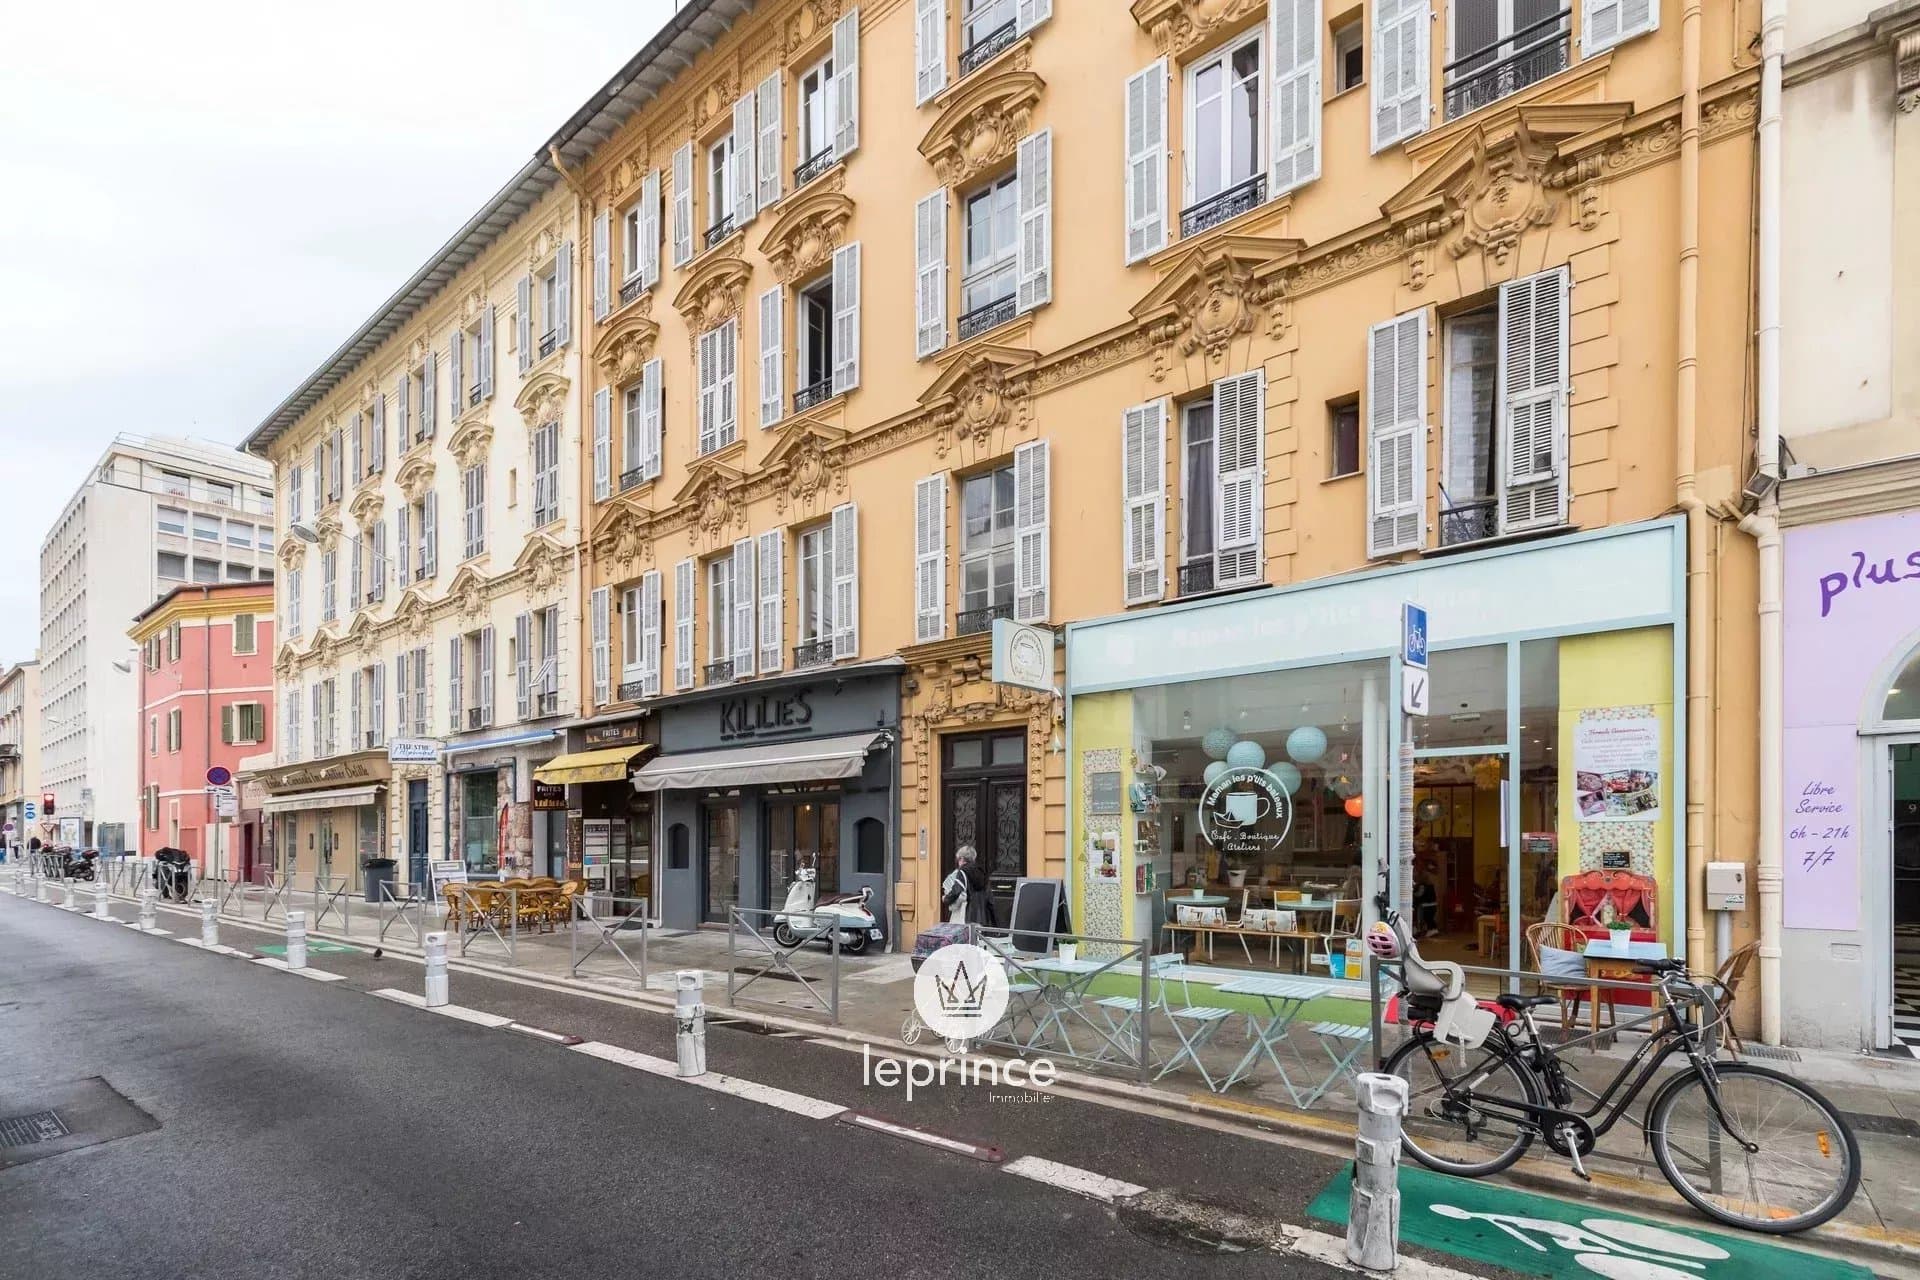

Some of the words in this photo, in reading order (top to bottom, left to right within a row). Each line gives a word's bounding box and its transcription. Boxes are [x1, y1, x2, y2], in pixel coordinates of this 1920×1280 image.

[602, 728, 620, 737] FRITES
[1802, 781, 1835, 796] Libre
[1206, 779, 1232, 806] Maman
[1232, 774, 1246, 784] les
[1265, 783, 1283, 819] bateaux
[1795, 798, 1843, 814] Service
[1210, 829, 1232, 842] Café
[1239, 831, 1280, 842] Boutique
[1789, 825, 1807, 840] 6h
[1822, 824, 1851, 839] 21h
[1227, 842, 1261, 851] Ateliers
[1802, 845, 1836, 873] 7/7
